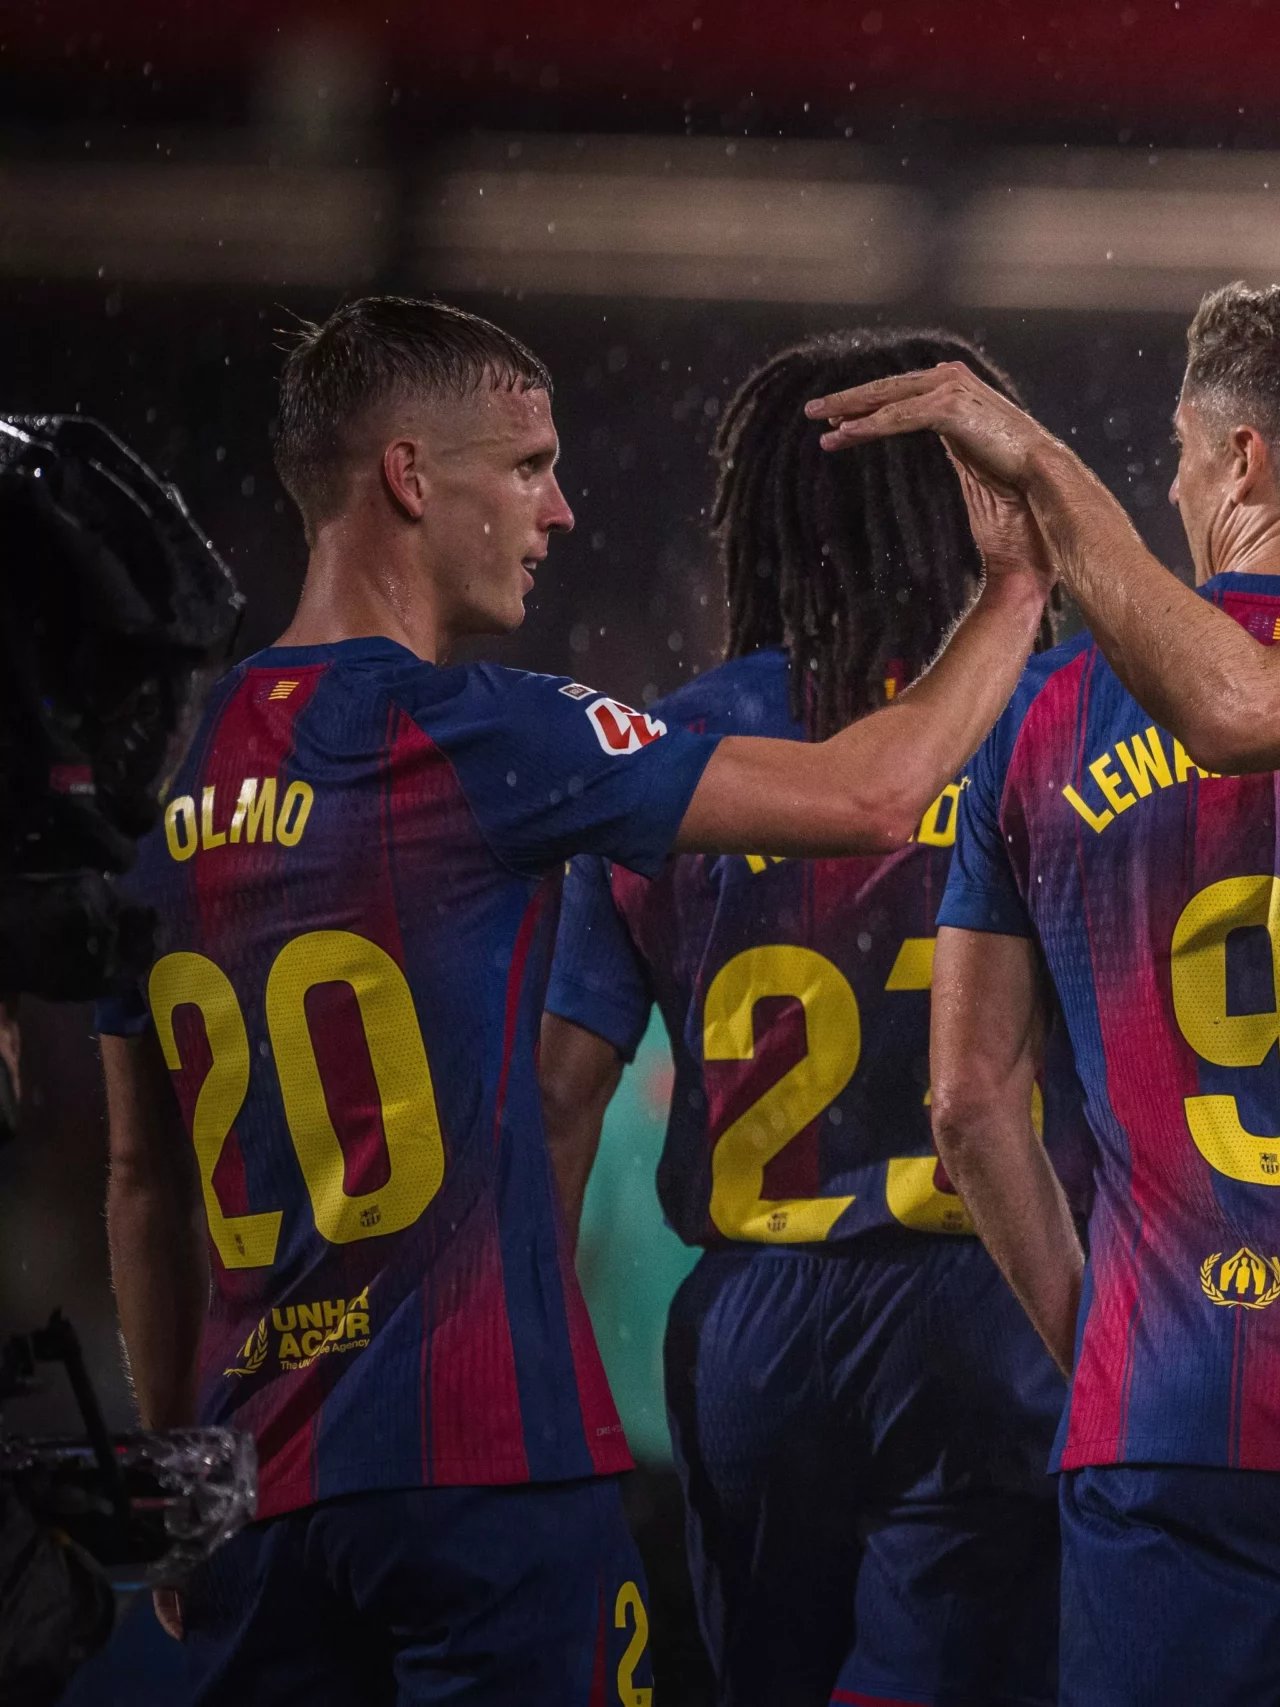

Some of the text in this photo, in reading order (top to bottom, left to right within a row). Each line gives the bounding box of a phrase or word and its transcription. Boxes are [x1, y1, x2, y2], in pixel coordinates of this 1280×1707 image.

[164, 776, 314, 862] OLMO
[148, 929, 445, 1269] 20
[279, 1360, 297, 1371] The
[332, 1338, 370, 1353] Agency
